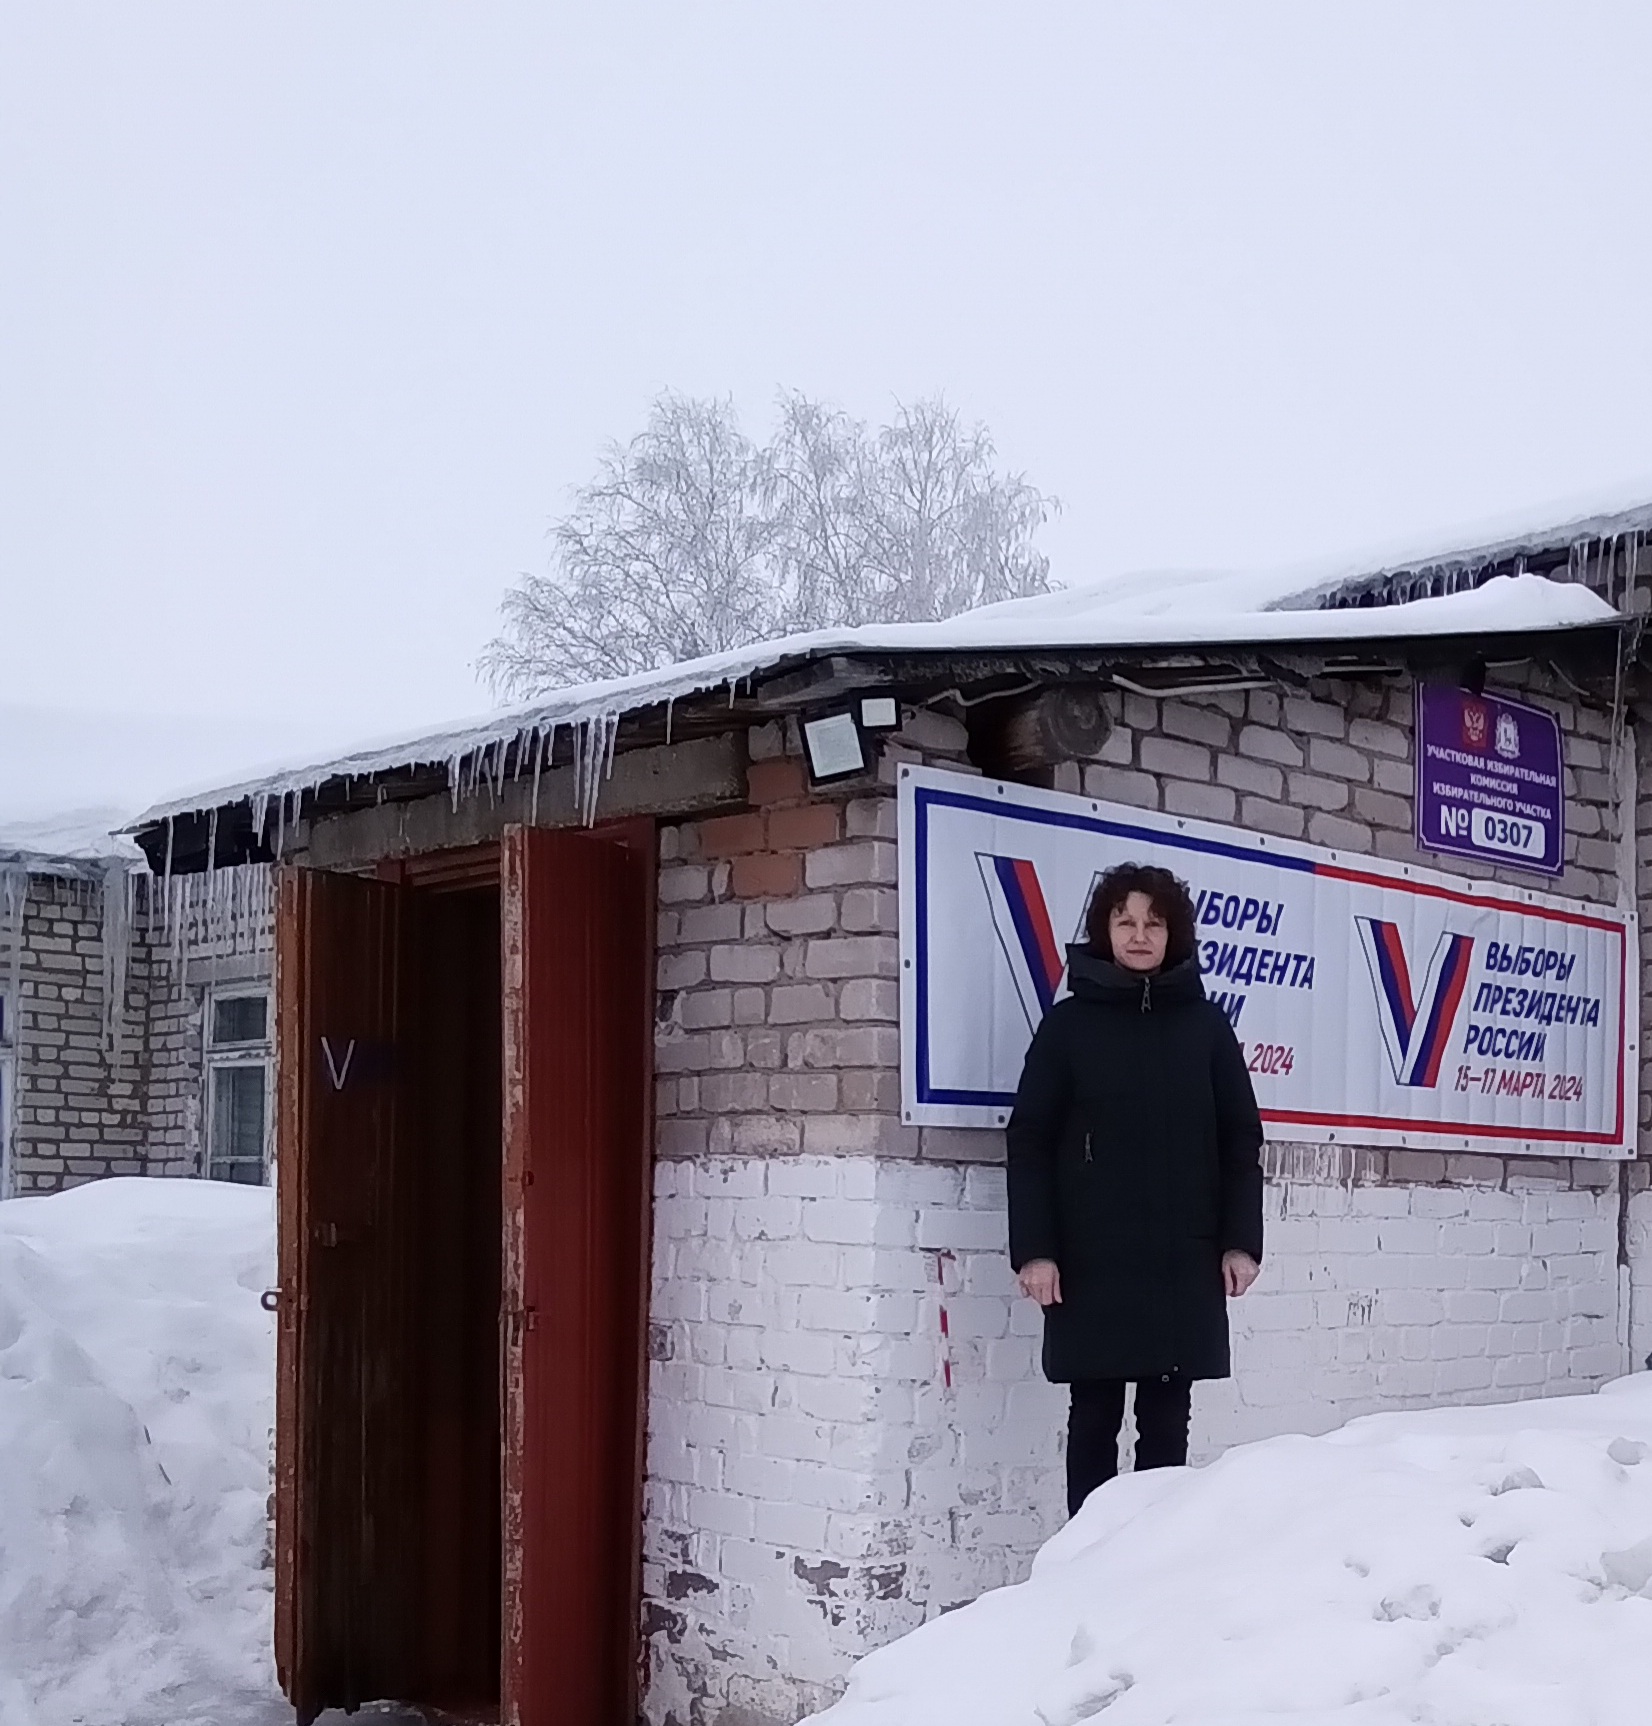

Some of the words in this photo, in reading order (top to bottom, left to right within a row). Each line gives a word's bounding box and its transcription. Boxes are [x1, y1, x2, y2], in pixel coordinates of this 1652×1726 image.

[1427, 744, 1485, 771] УЧАСТКОВАЯ
[1487, 759, 1556, 788] ИЗБИРАТЕЛЬНАЯ
[1470, 773, 1518, 795] КОМИССИЯ
[1433, 782, 1513, 812] ИЗБИРАТЕЛЬНОГО
[1515, 799, 1551, 820] УЧАСТКА
[1484, 815, 1533, 849] 0307
[1195, 889, 1284, 936] БОРЫ
[1200, 940, 1315, 990] ЗИДЕНТА
[1486, 941, 1576, 982] ВЫБОРЫ
[1473, 982, 1600, 1027] ПРЕЗИДЕНТА
[1249, 1043, 1294, 1075] 2024
[1463, 1024, 1547, 1062] РОССИИ
[1496, 1068, 1546, 1099] МАРТА
[1548, 1074, 1583, 1101] 2024
